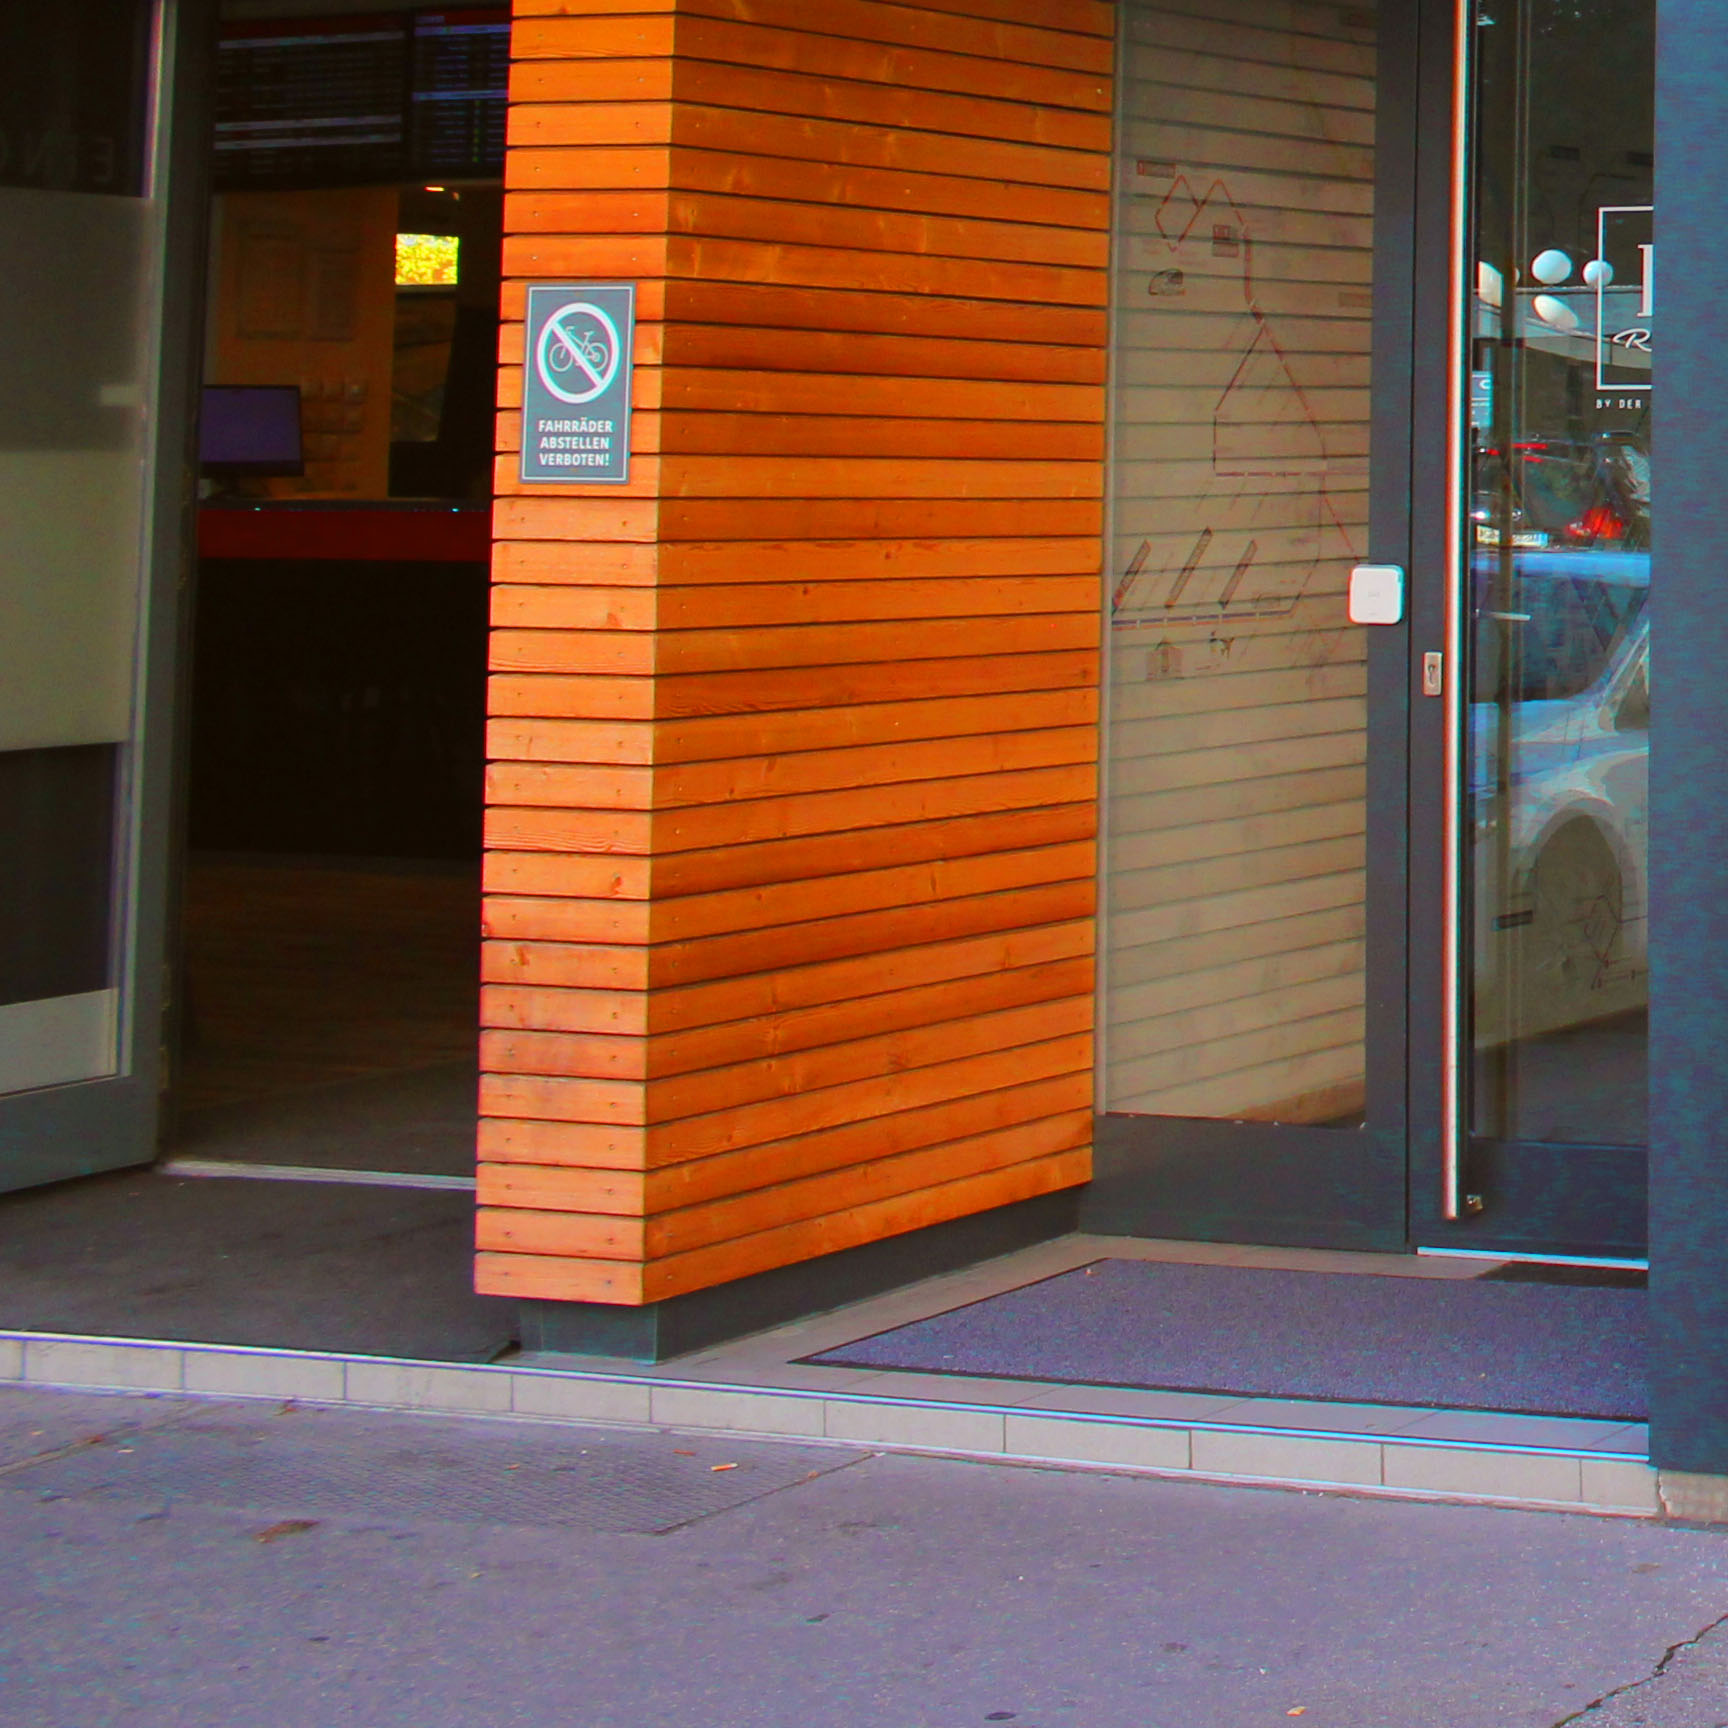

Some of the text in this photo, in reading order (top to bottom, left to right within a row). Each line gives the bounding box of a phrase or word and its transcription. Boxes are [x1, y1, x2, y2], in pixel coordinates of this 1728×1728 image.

[1595, 398, 1642, 410] BY DER
[538, 417, 613, 433] FAHRRÄDER
[540, 437, 610, 450] ABSTELLEN
[539, 453, 610, 467] VERBOTEN!
